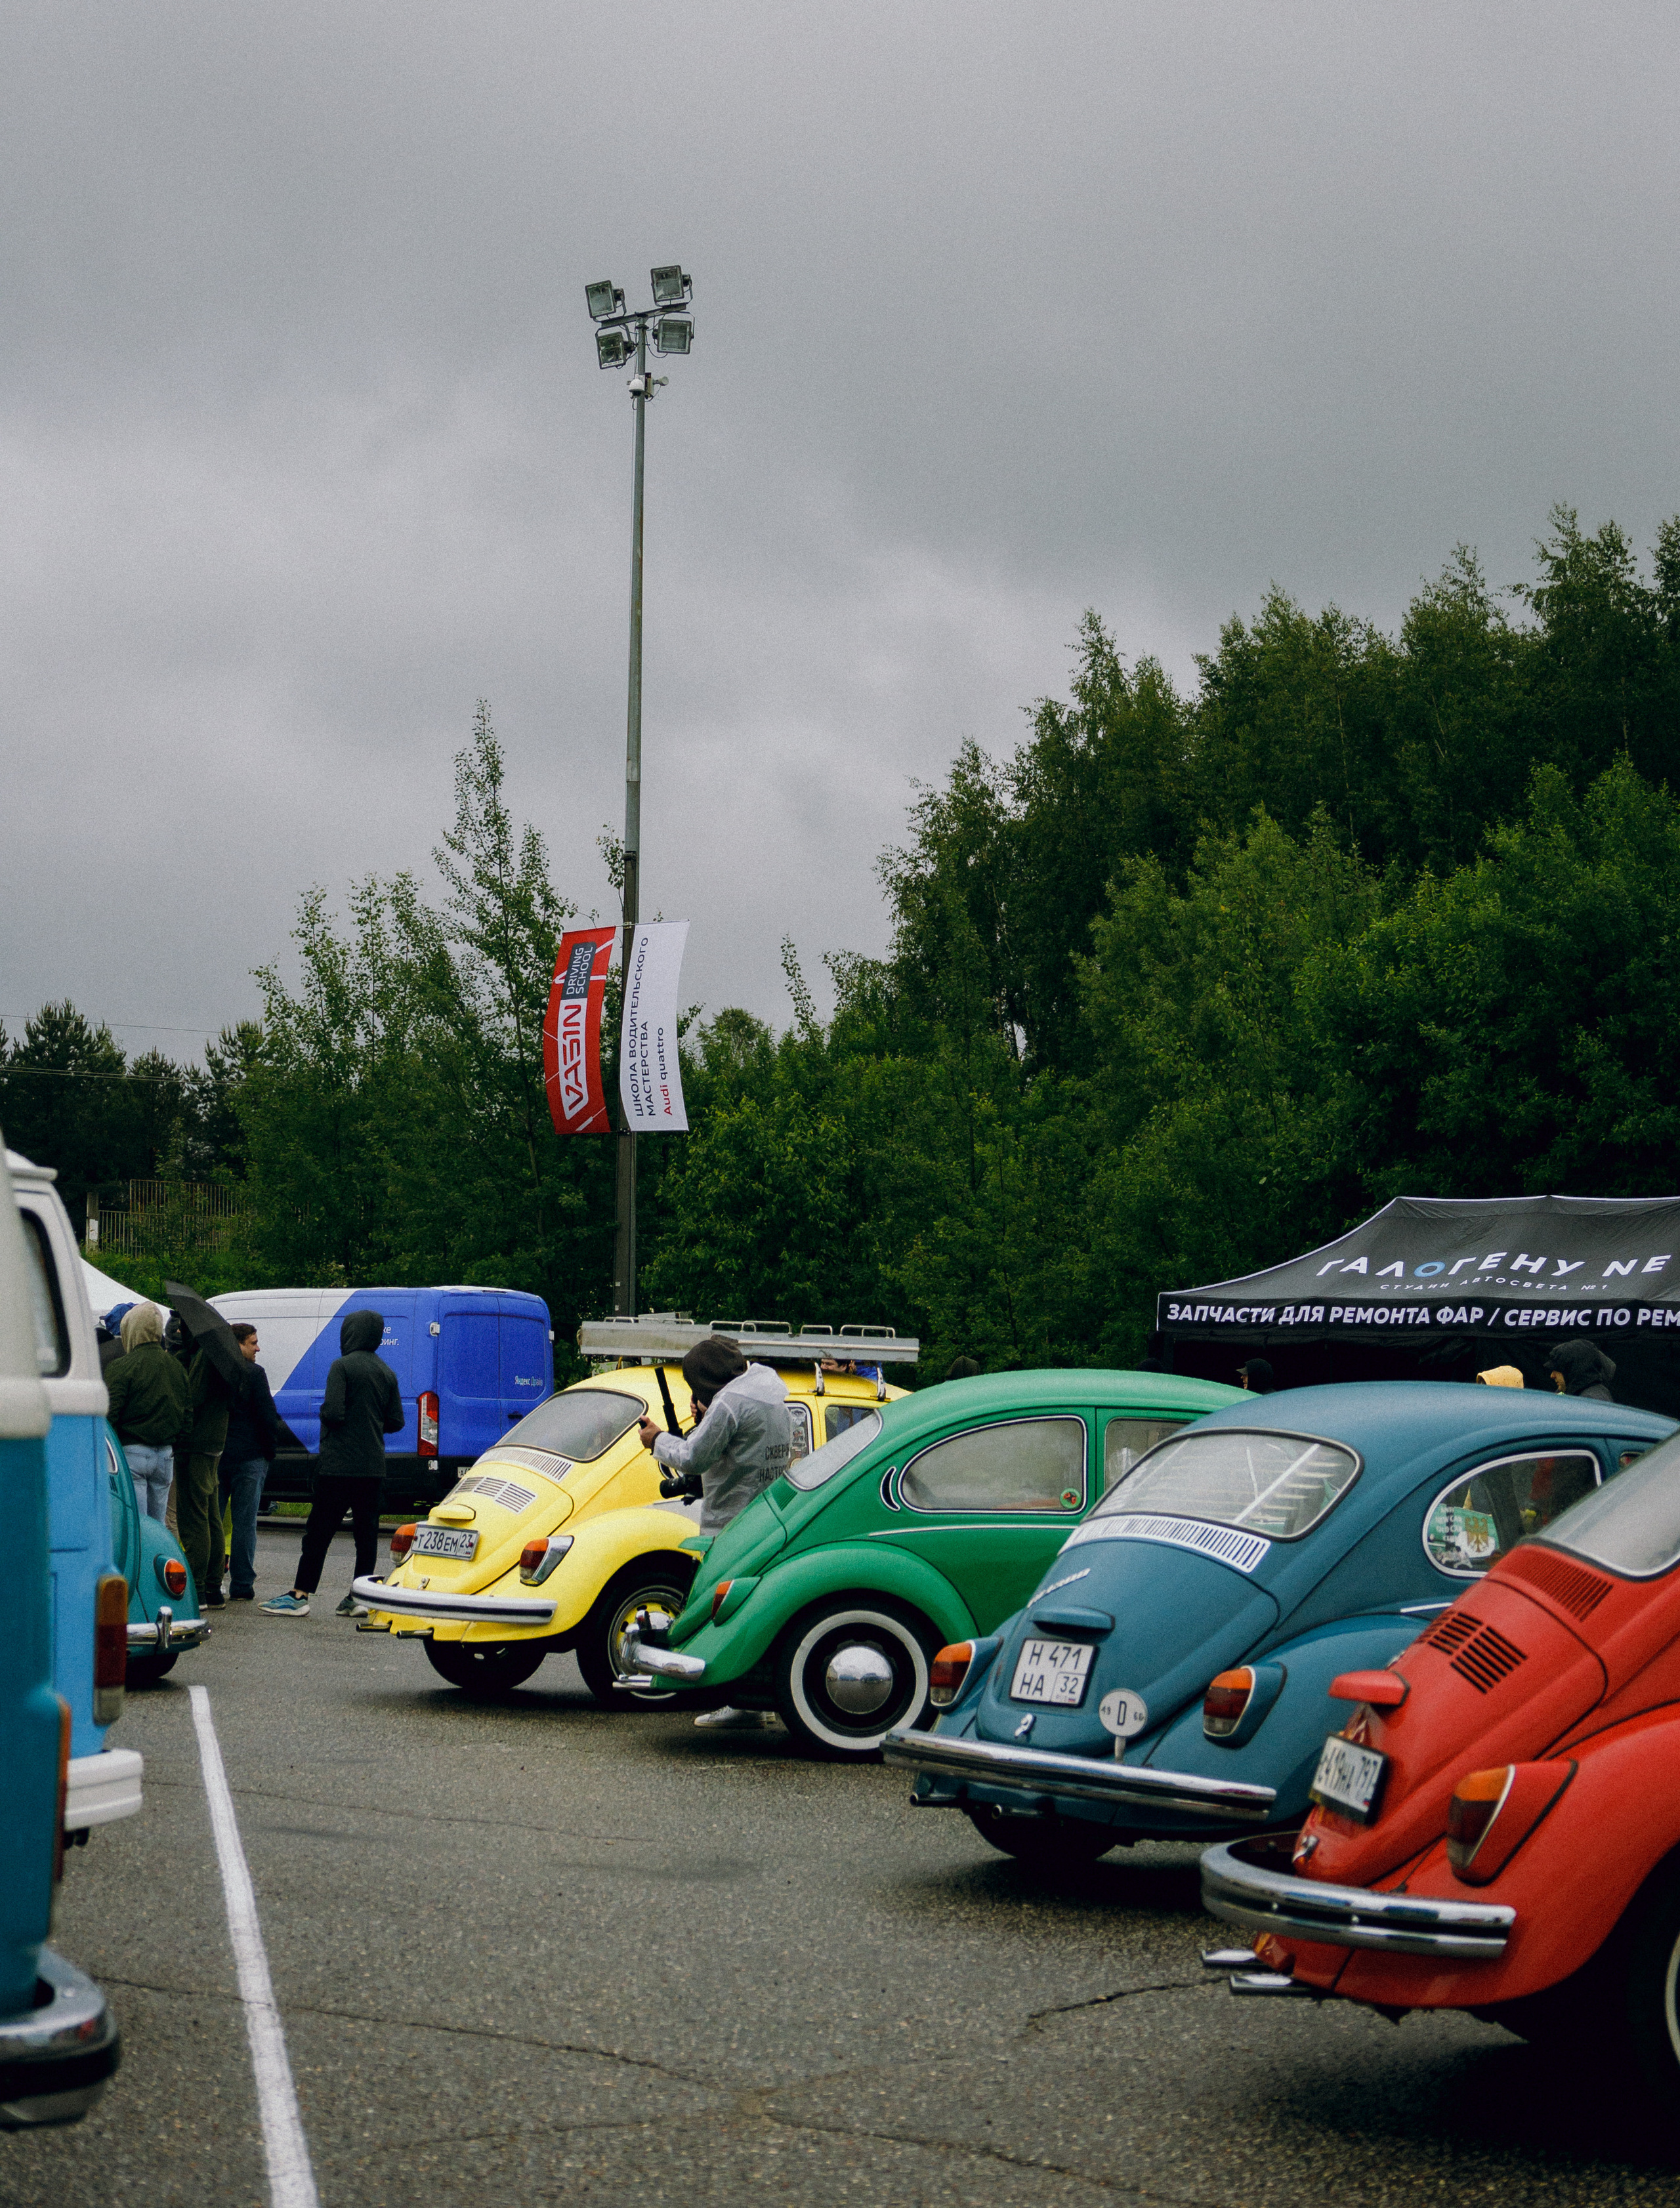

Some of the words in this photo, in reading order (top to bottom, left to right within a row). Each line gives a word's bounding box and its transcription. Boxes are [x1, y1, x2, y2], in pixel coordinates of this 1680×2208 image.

[566, 948, 584, 995] DRIVING
[575, 946, 593, 994] SCHOOL
[629, 937, 648, 1058] ВОДИТЕЛЬСКОГО
[562, 1005, 583, 1112] VASIN
[640, 1021, 656, 1116] МАСТЕРСТВА
[657, 1028, 668, 1080] quattro
[629, 1062, 644, 1116] ШКОЛА
[660, 1085, 673, 1115] Audi
[1316, 1252, 1586, 1278] ГАЛОГЕНУ
[1460, 1276, 1567, 1290] АВТОСВЕТА
[1167, 1303, 1276, 1323] ЗАПЧАСТИ
[1278, 1306, 1324, 1325] ДЛЯ
[1329, 1307, 1430, 1324] РЕМОНТА
[1436, 1306, 1484, 1324] ФАР
[1504, 1309, 1592, 1326] СЕРВИС
[1597, 1308, 1631, 1326] ПО
[1637, 1308, 1680, 1327] РЕМ
[459, 1533, 474, 1549] 23
[1049, 1646, 1082, 1670] 471
[1019, 1673, 1045, 1697] НА
[1060, 1676, 1079, 1694] 32
[1117, 1700, 1127, 1726] D
